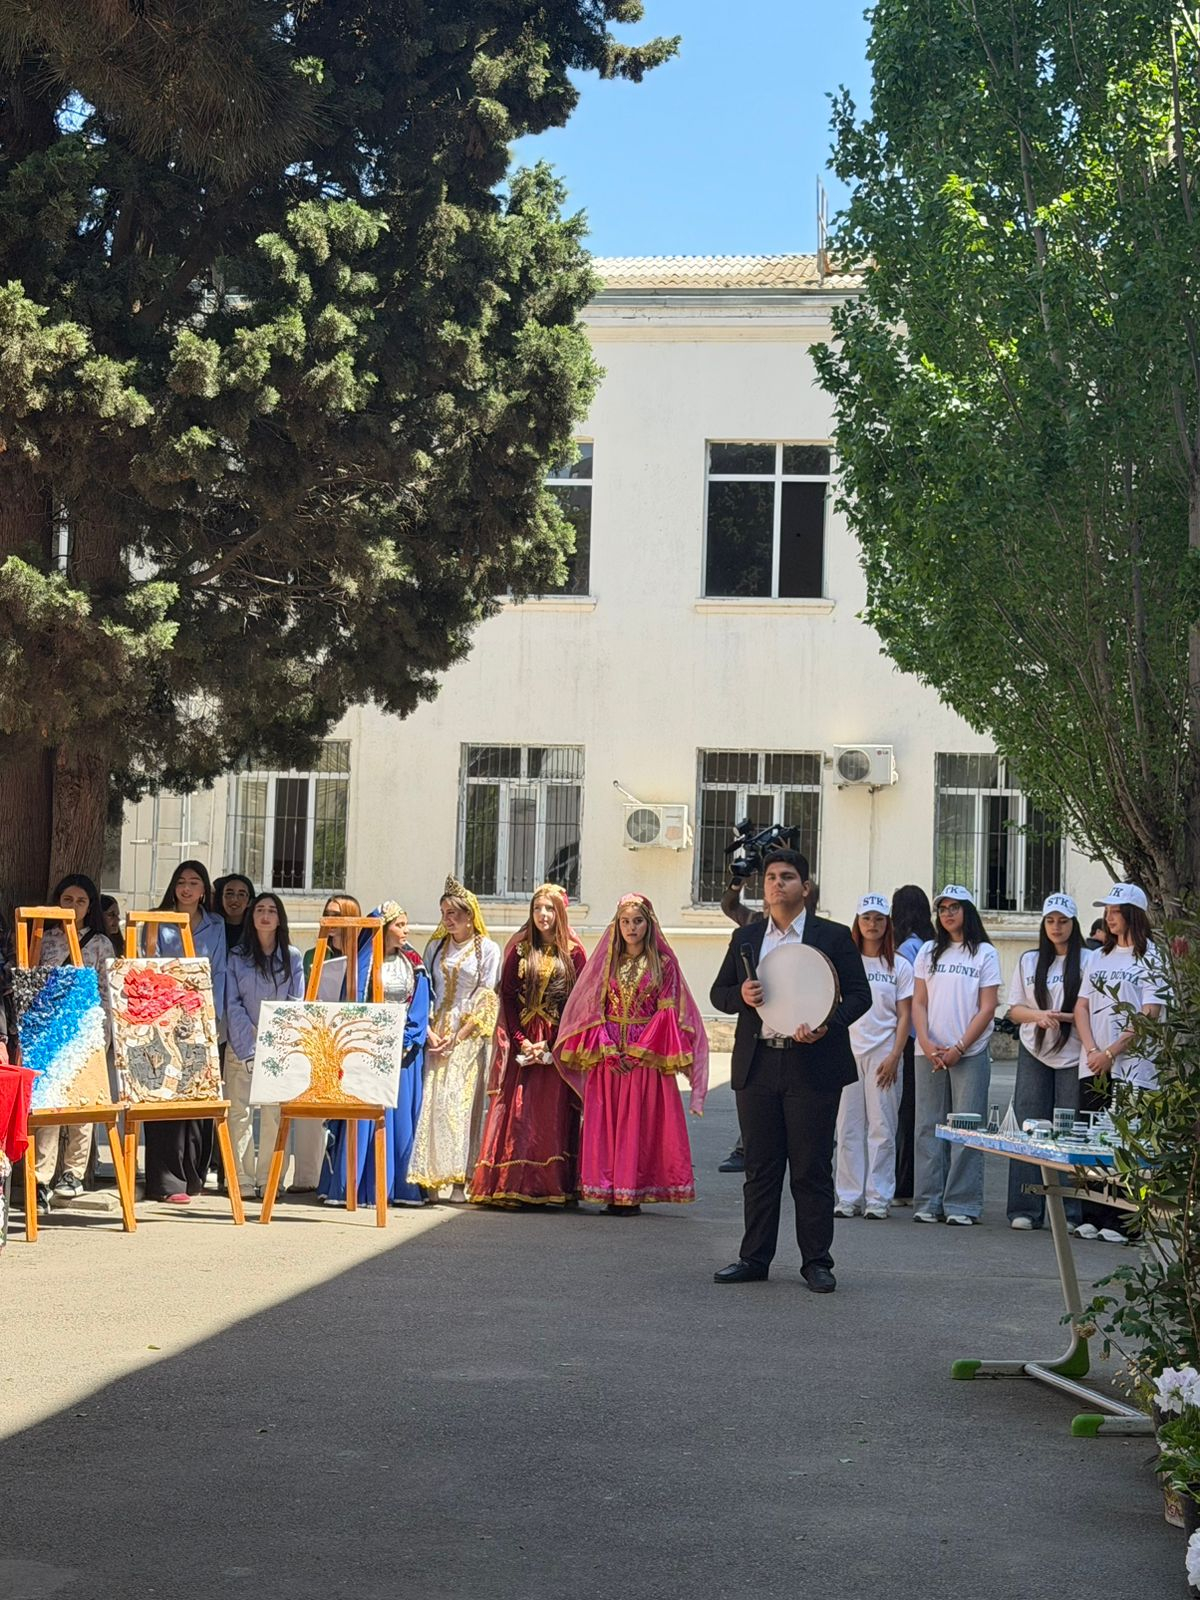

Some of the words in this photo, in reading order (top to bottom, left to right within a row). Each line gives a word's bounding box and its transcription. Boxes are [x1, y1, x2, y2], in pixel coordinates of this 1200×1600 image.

[945, 886, 959, 894] TK
[1109, 886, 1124, 898] TK
[862, 895, 884, 907] STK
[1047, 896, 1069, 908] STK
